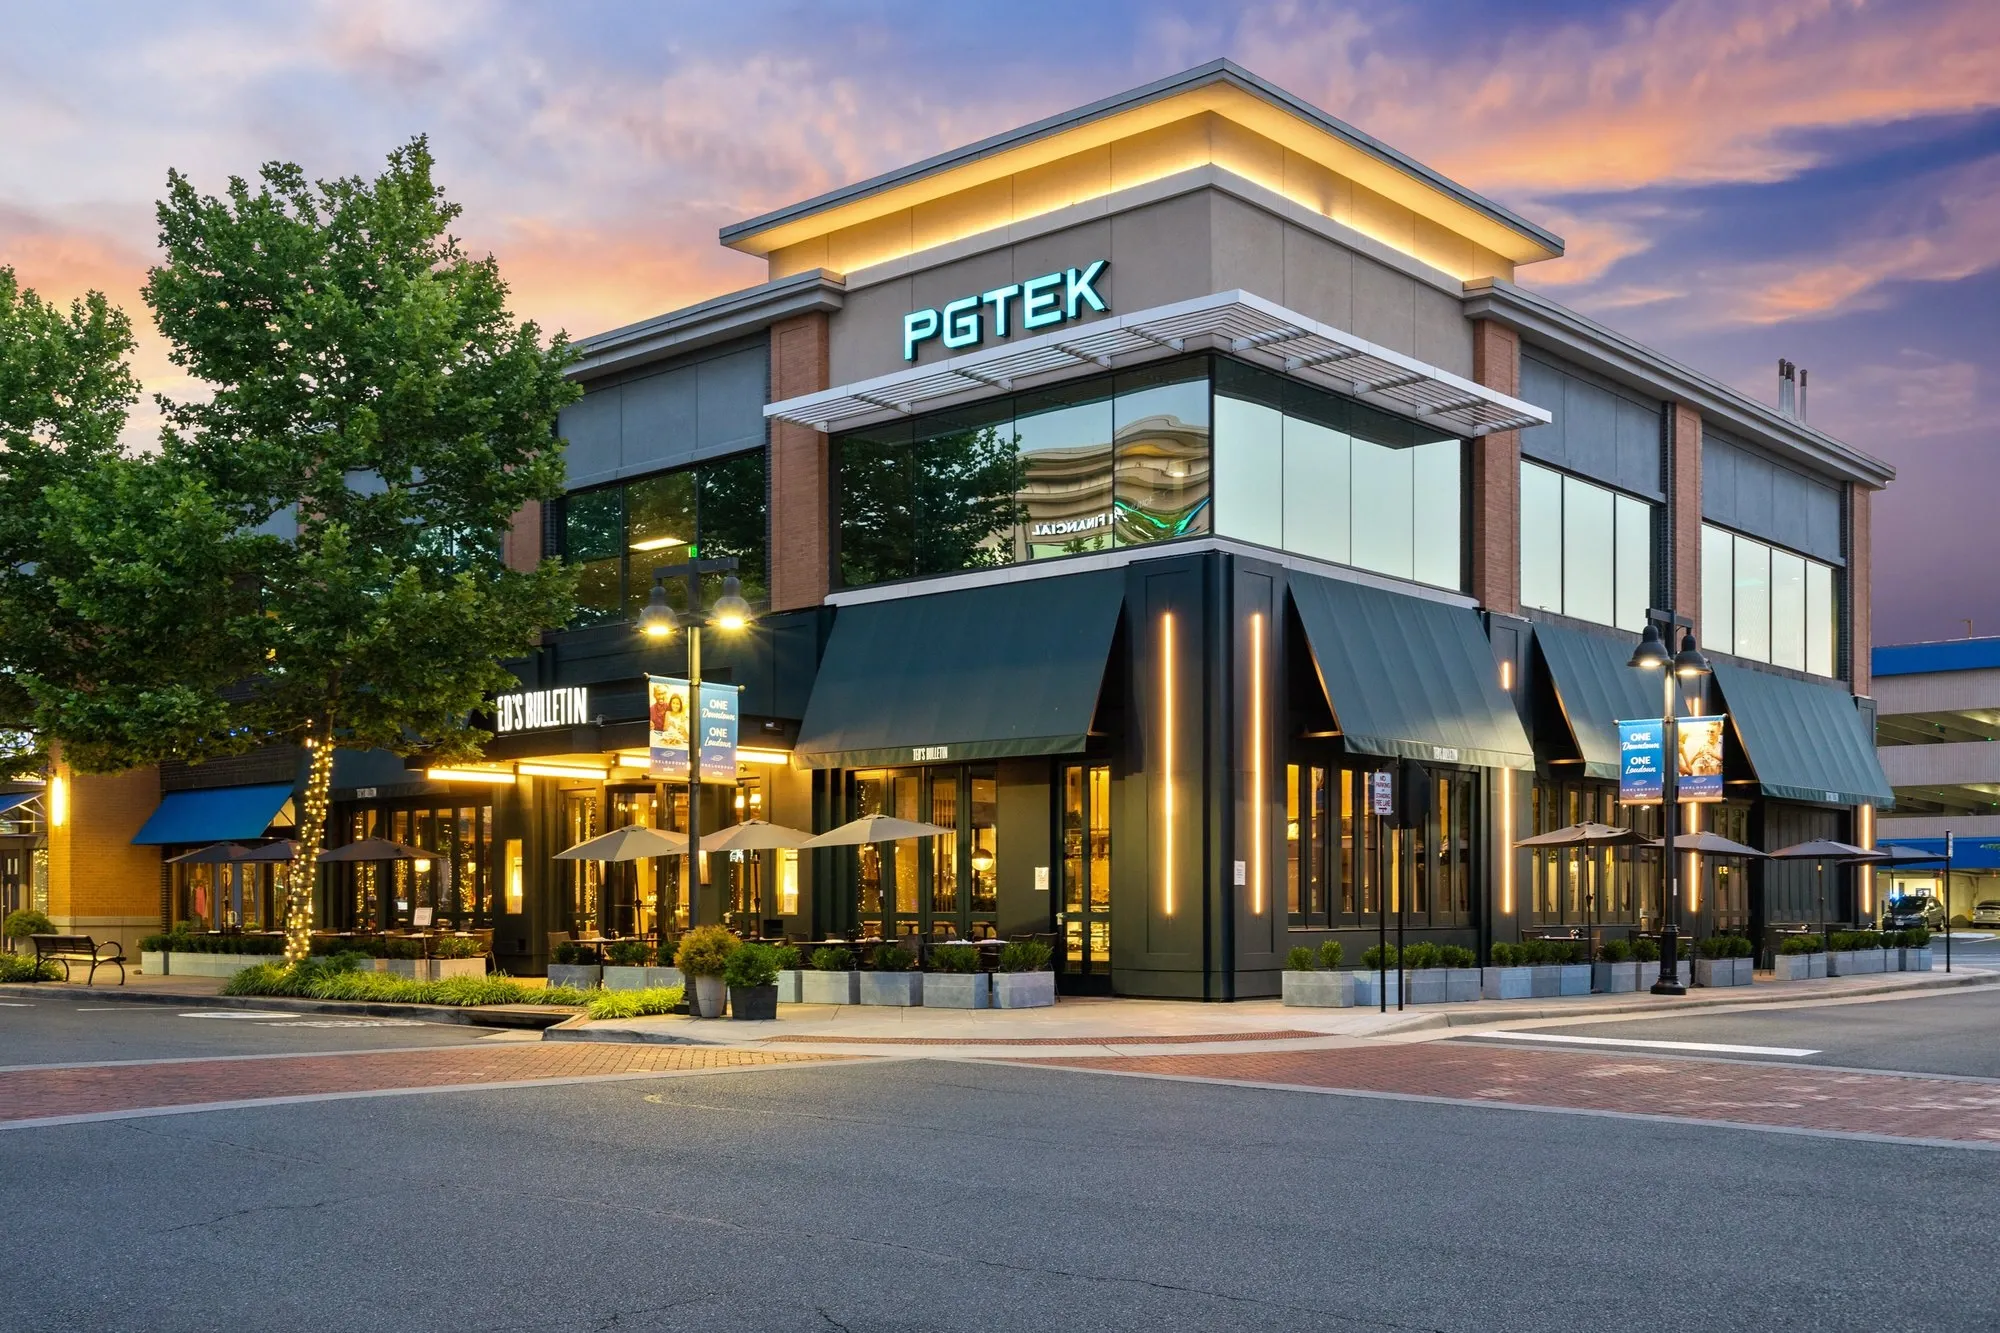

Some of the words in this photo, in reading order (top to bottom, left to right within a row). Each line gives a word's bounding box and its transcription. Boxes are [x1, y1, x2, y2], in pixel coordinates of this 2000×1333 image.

[904, 259, 1111, 361] PGTEK
[524, 687, 588, 728] BULLETIN
[709, 699, 728, 710] ONE
[709, 727, 728, 738] ONE
[1630, 732, 1651, 742] ONE
[1630, 756, 1651, 766] ONE
